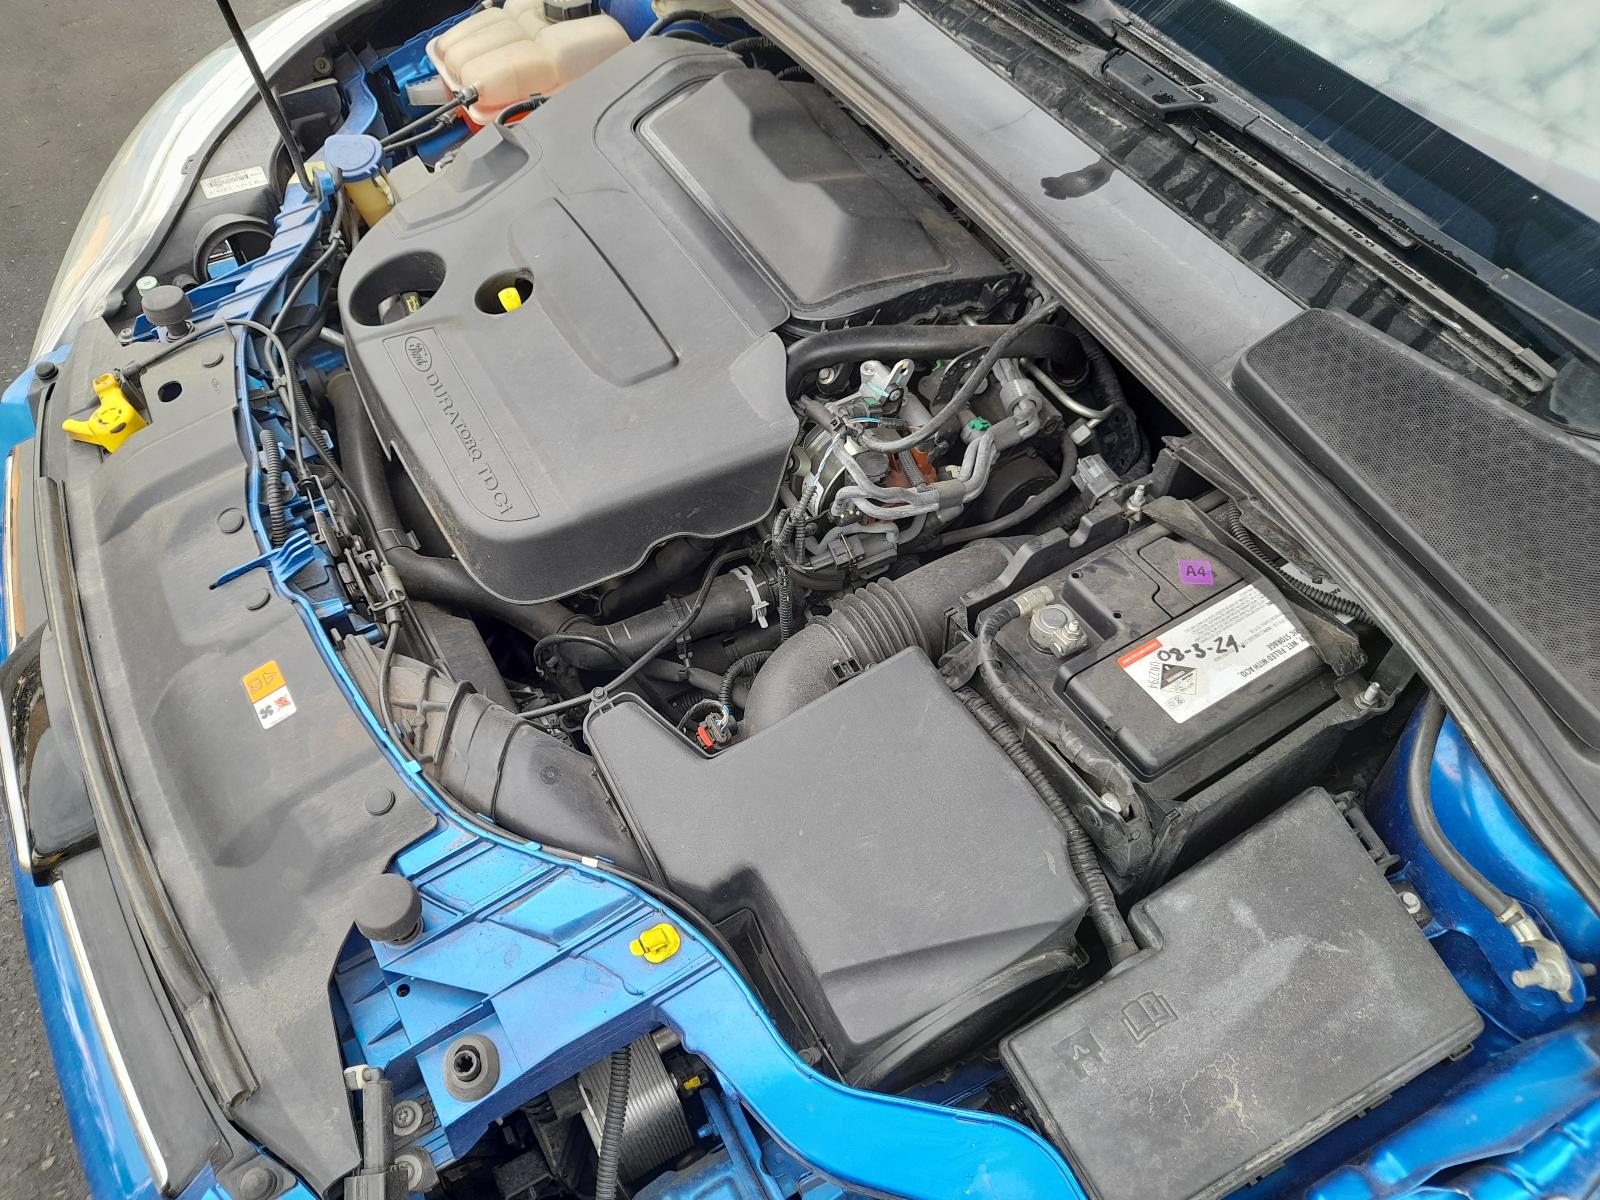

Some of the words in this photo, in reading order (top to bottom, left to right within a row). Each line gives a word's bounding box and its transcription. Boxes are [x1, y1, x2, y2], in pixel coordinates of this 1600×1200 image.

[1186, 565, 1206, 577] A4
[1266, 633, 1292, 651] STORAGE
[1266, 648, 1287, 661] FILLED
[1252, 657, 1269, 671] WITH
